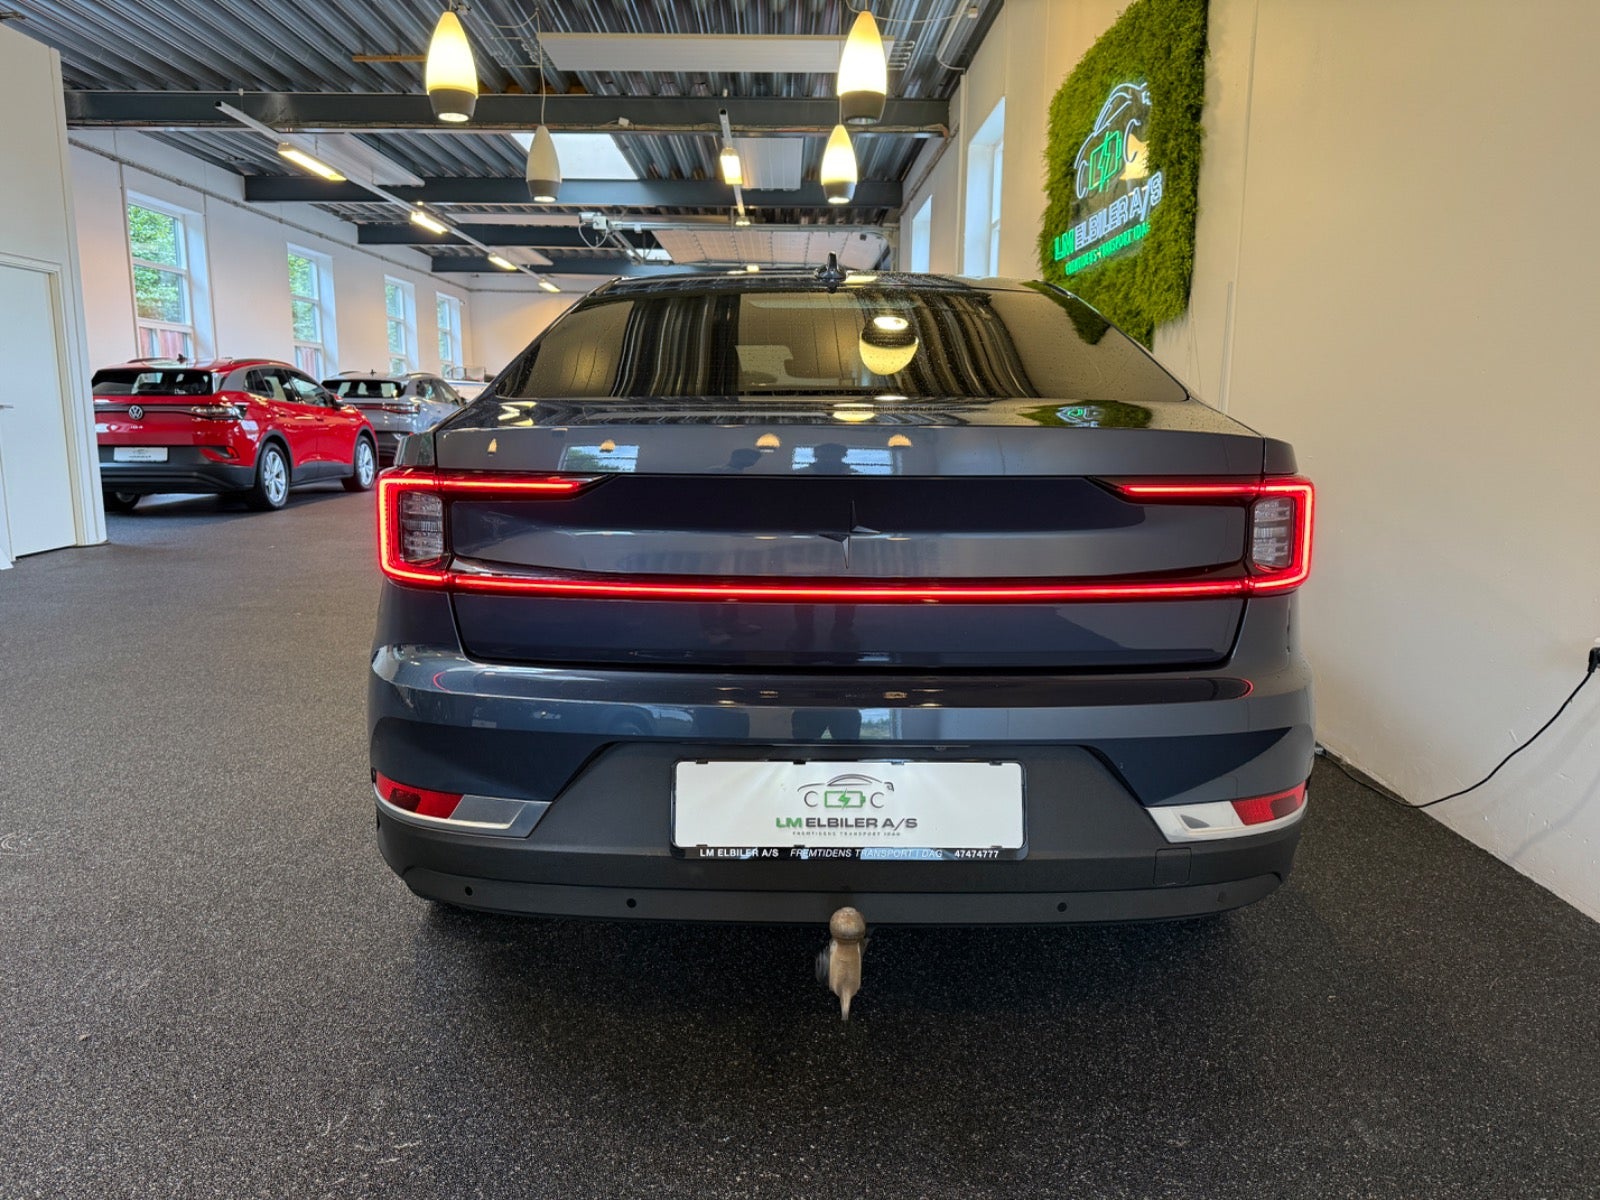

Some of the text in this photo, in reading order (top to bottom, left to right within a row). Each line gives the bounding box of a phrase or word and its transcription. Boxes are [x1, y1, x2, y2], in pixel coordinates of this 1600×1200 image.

[1054, 171, 1162, 261] LM ELBILER A/S
[776, 817, 918, 830] LM ELBILER A/S
[699, 848, 715, 857] LM
[717, 848, 759, 857] ELBILER
[761, 848, 779, 857] A/S
[790, 848, 852, 857] FREMTIDENS
[854, 849, 913, 858] TRANSPORT
[921, 850, 943, 858] DAG
[954, 850, 999, 859] 47474777
